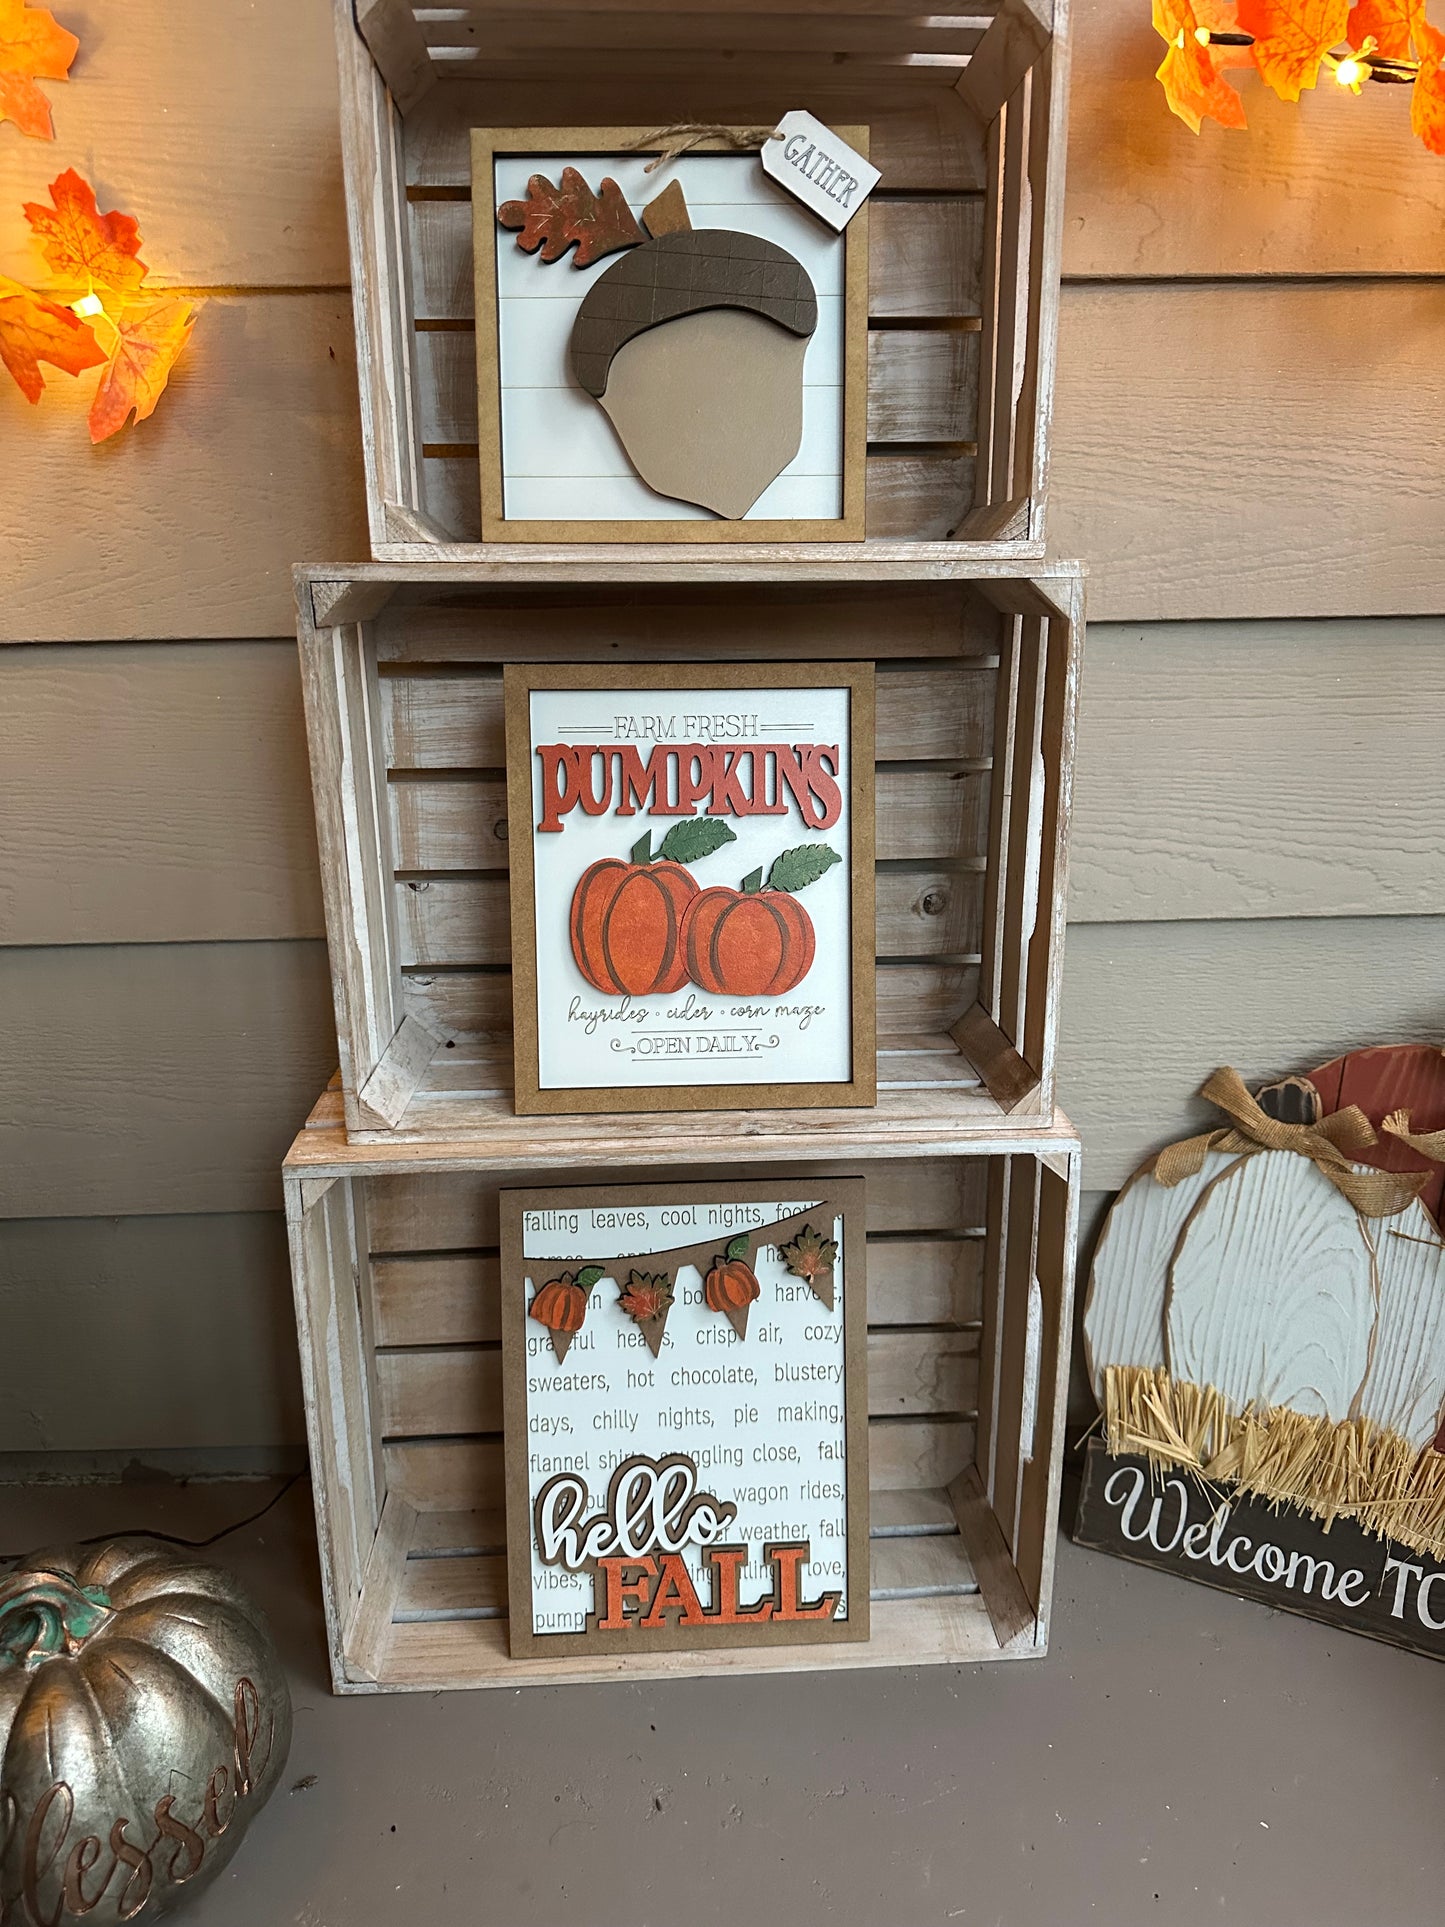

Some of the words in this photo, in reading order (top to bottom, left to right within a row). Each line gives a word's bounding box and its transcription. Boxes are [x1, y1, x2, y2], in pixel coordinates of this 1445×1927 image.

[783, 134, 859, 209] GATHER
[613, 715, 676, 743] FARM
[683, 714, 759, 743] FRESH
[536, 743, 842, 833] PUMPKINS
[567, 995, 650, 1035] hayrides
[666, 994, 713, 1021] cider
[730, 1006, 771, 1019] corn
[774, 1004, 826, 1031] maze
[636, 1036, 692, 1055] OPEN
[696, 1034, 757, 1053] DAILY
[524, 1211, 579, 1234] falling
[590, 1210, 650, 1230] leaves,
[660, 1206, 697, 1226] cool
[708, 1205, 765, 1228] nights,
[696, 1325, 737, 1348] crisp
[758, 1323, 783, 1345] air,
[804, 1325, 843, 1344] cozy
[528, 1374, 611, 1393] sweaters,
[627, 1369, 655, 1388] hot
[671, 1365, 758, 1387] chocolate,
[774, 1363, 843, 1384] blustery
[529, 1414, 574, 1436] days,
[592, 1409, 639, 1432] chilly
[658, 1406, 715, 1430] nights,
[734, 1404, 759, 1428] pie
[778, 1400, 844, 1424] making,
[529, 1451, 590, 1473] flannel
[753, 1443, 801, 1463] close,
[818, 1440, 845, 1460] fall
[733, 1484, 788, 1505] wagon
[800, 1480, 845, 1501] rides,
[541, 1464, 733, 1569] hello
[739, 1521, 811, 1541] weather,
[819, 1518, 846, 1538] fall
[1104, 1466, 1371, 1608] Welcome
[533, 1571, 583, 1591] vibes,
[806, 1560, 846, 1578] love,
[597, 1548, 835, 1630] FALL
